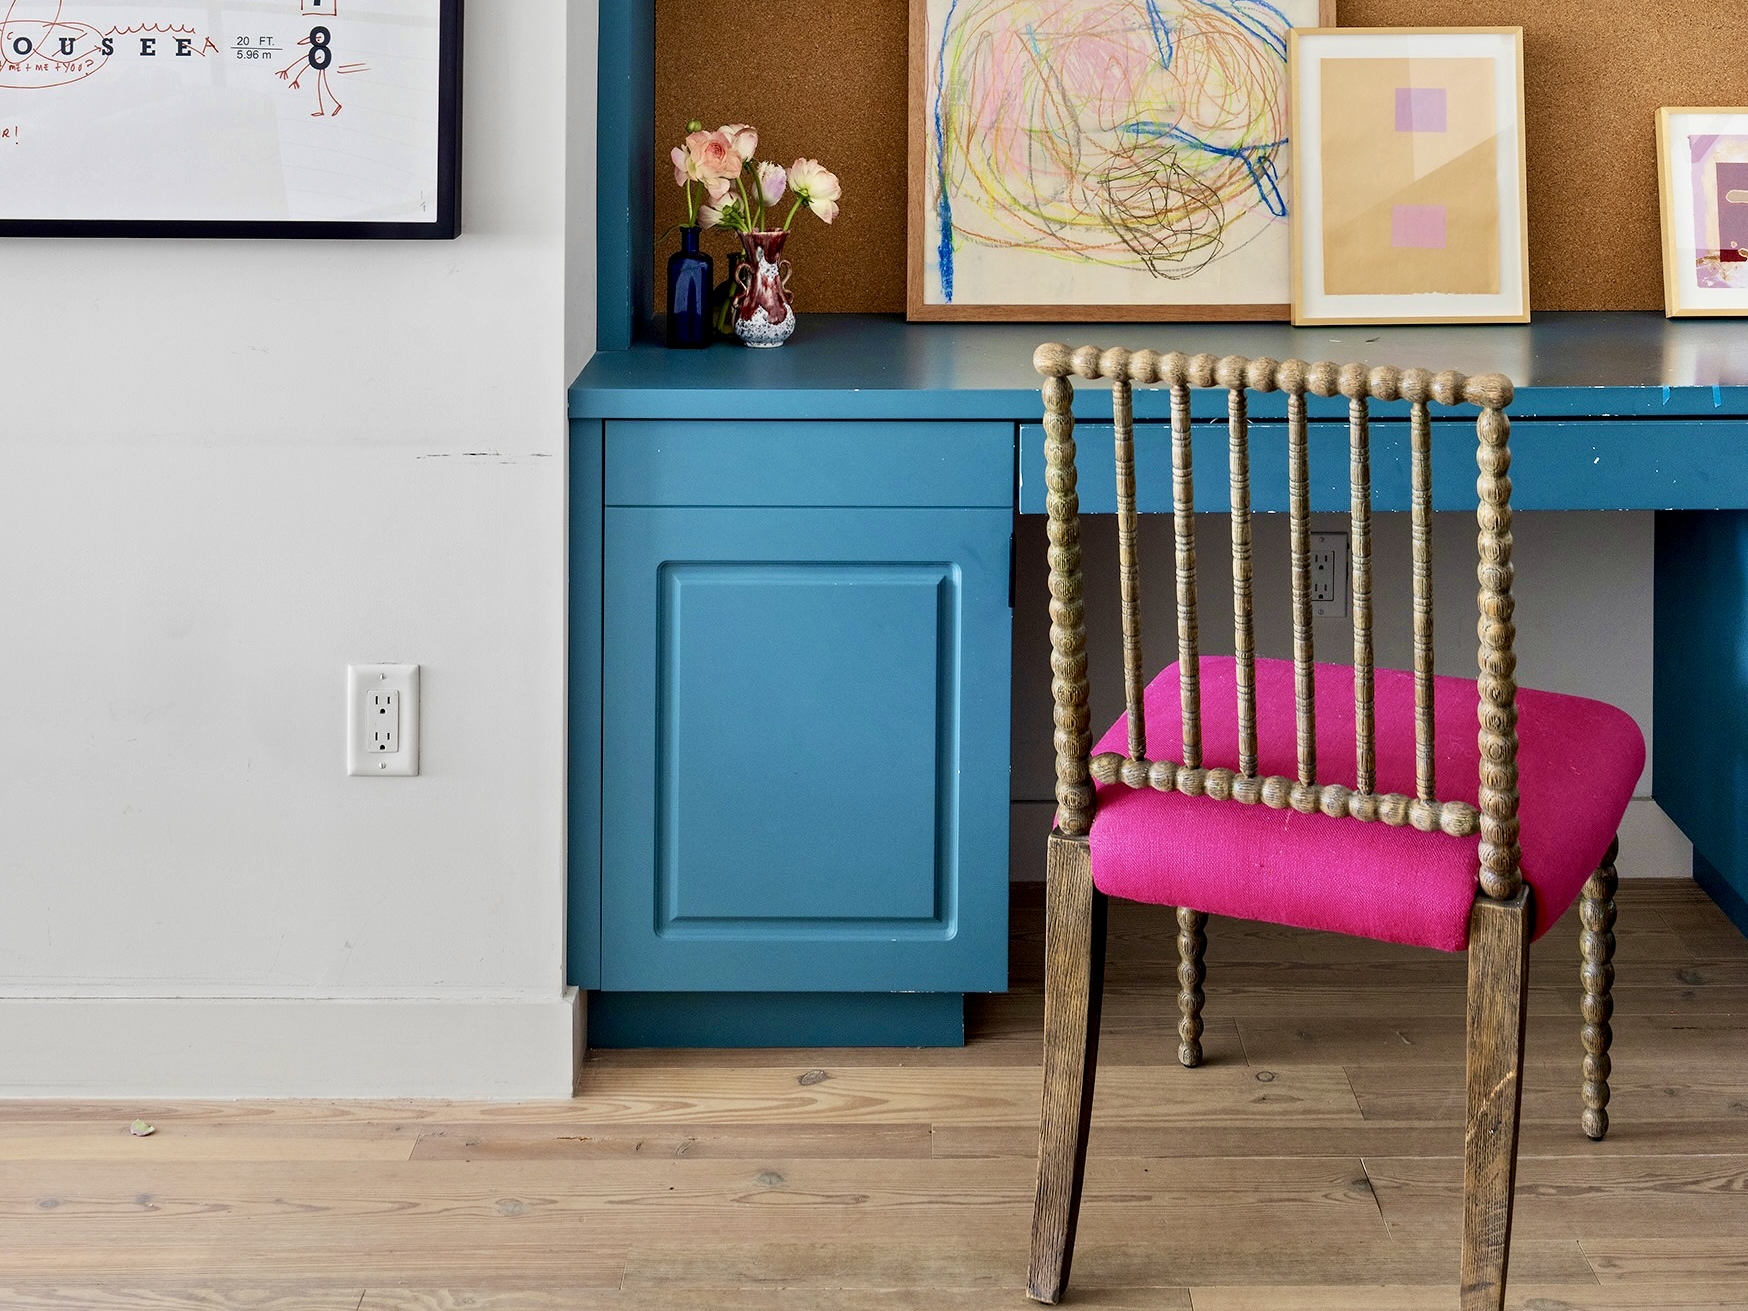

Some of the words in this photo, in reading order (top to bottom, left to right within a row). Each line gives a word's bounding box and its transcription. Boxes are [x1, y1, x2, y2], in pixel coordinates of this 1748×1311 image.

[236, 36, 250, 46] 20
[259, 37, 275, 47] FT.
[308, 25, 332, 71] 8
[236, 50, 259, 60] 5.96
[262, 52, 272, 60] m
